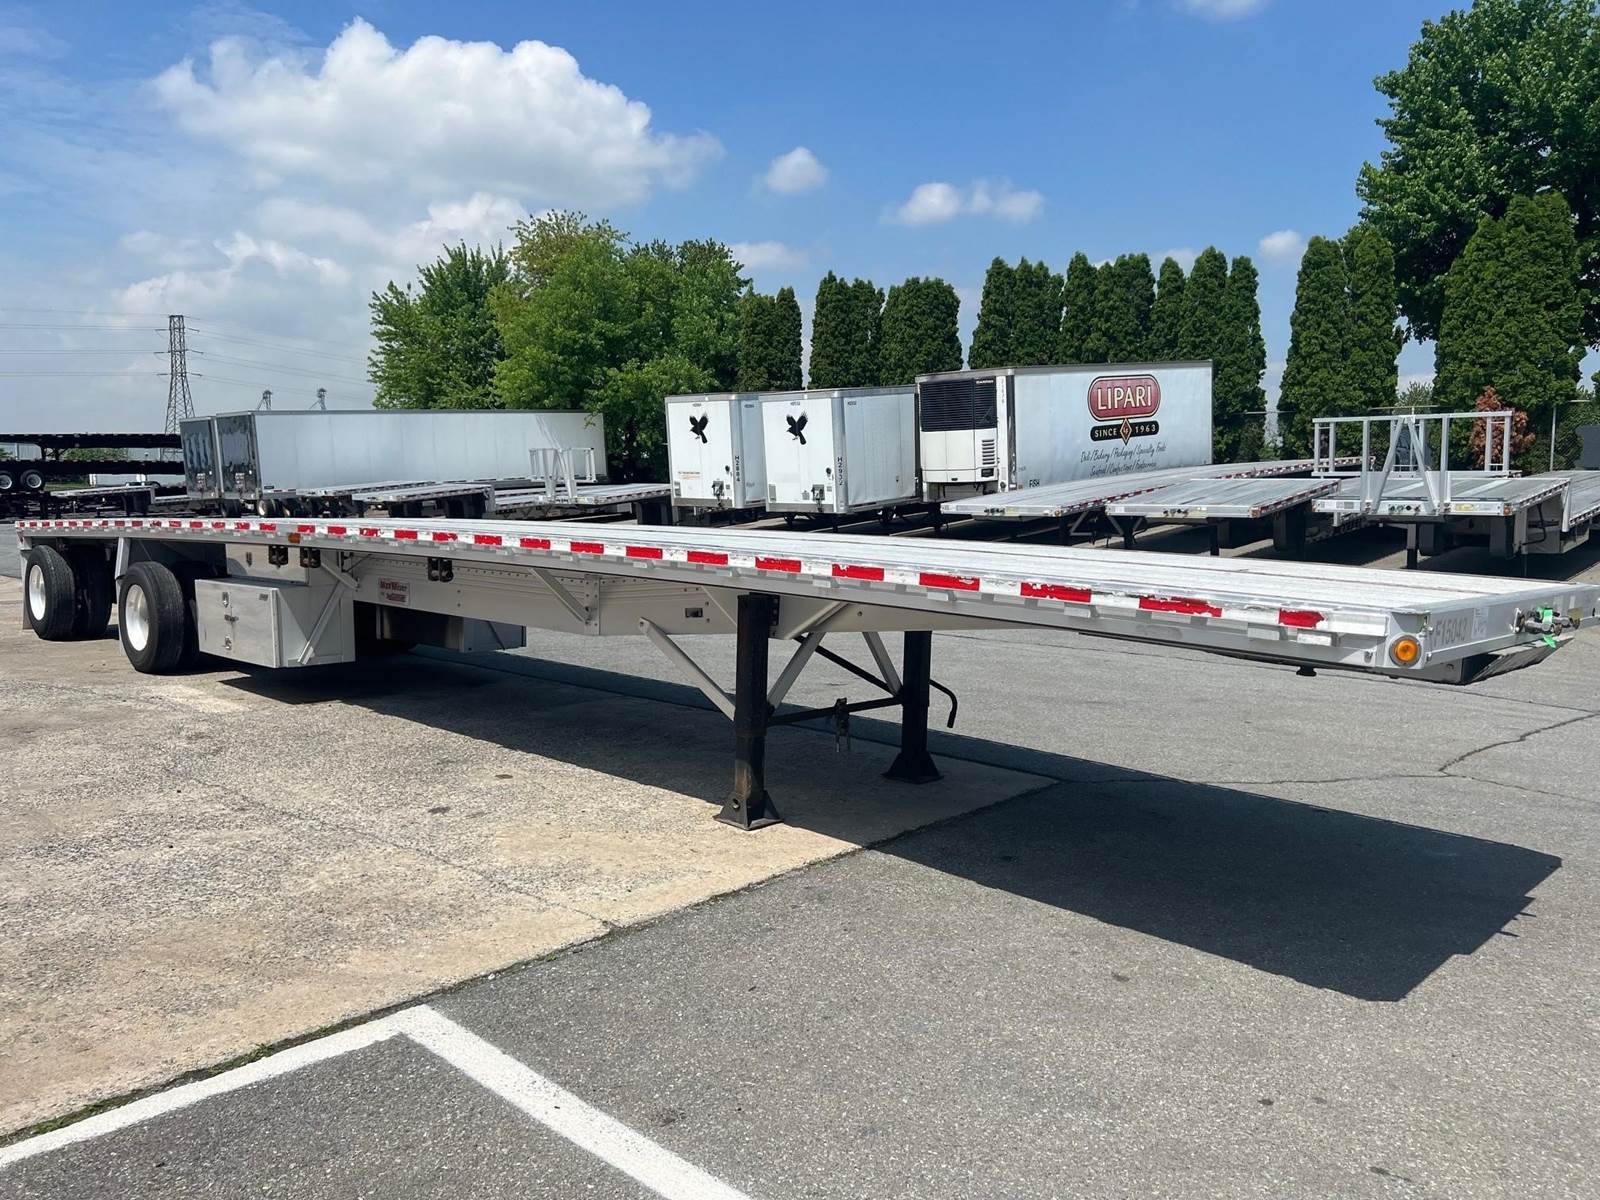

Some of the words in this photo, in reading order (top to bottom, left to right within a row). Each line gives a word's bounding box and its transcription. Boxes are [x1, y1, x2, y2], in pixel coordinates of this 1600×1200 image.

[1097, 386, 1152, 410] LIPARI
[1094, 428, 1117, 438] SINCE
[1135, 424, 1156, 434] 1963
